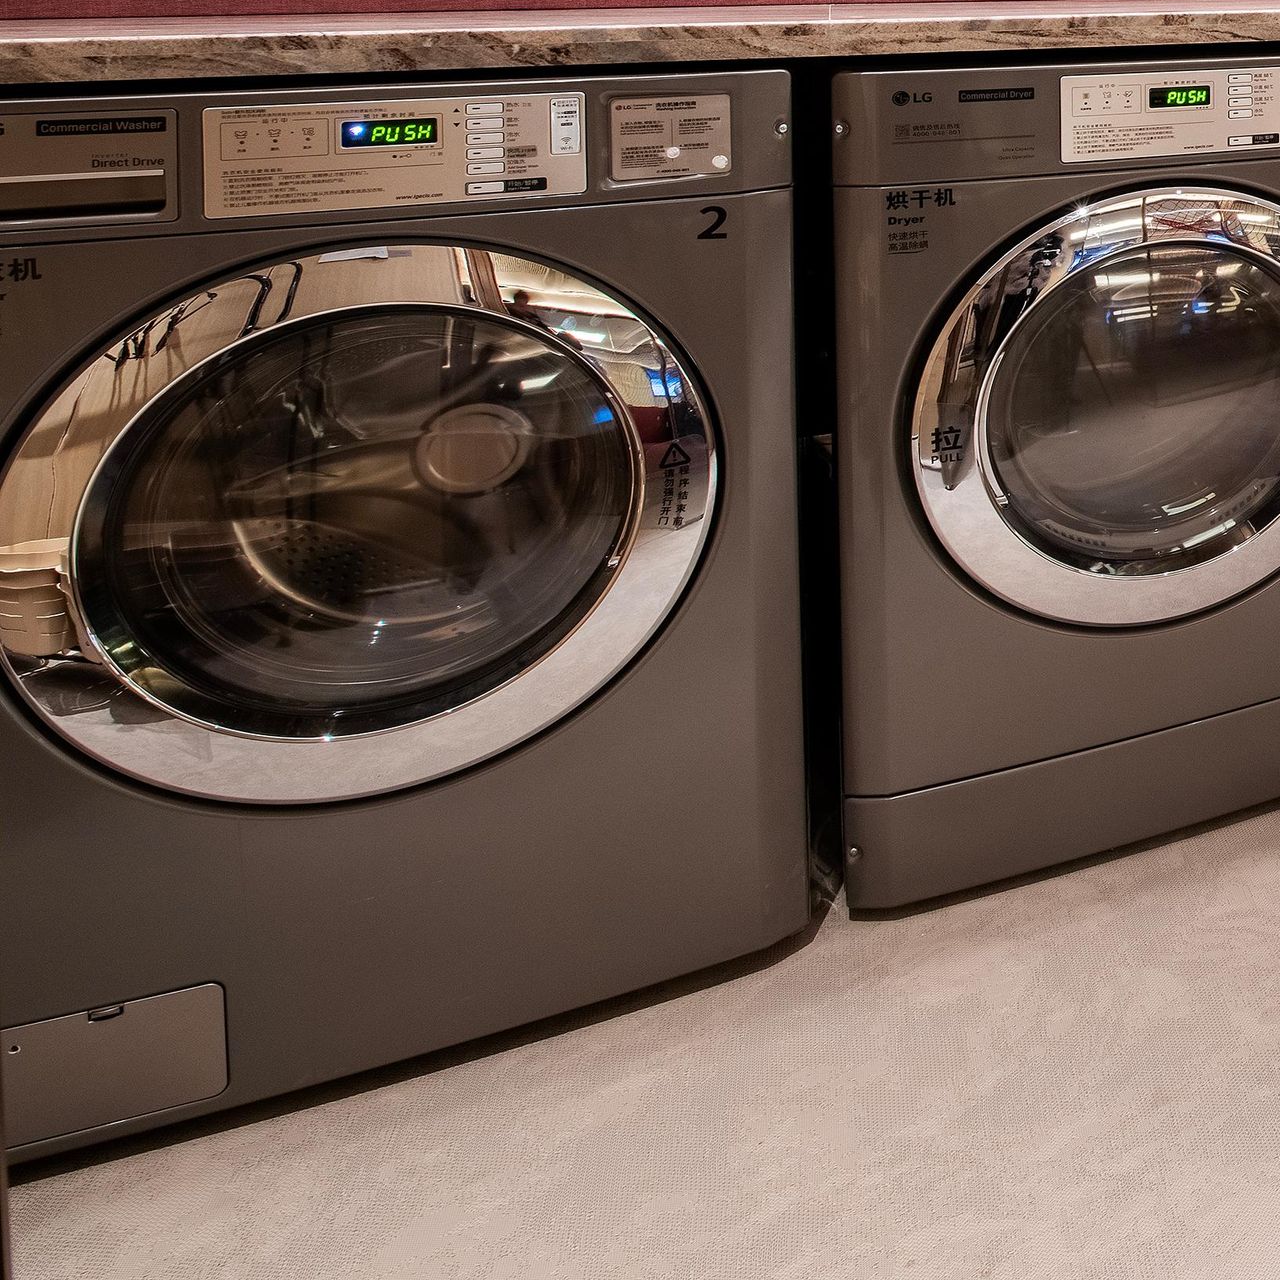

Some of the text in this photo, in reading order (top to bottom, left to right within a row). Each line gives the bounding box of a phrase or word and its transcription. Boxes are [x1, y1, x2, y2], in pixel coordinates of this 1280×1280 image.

[913, 93, 932, 103] LG
[961, 91, 1032, 101] Commercial Dryer
[1167, 90, 1206, 104] PUSH
[41, 121, 162, 133] Commercial Washer
[371, 125, 431, 142] PUSH
[92, 157, 164, 168] Direct Drive
[886, 189, 956, 210] 烘干机
[698, 206, 727, 239] 2
[888, 216, 925, 226] Dryer
[888, 231, 928, 241] 快速烘干
[0, 258, 42, 282] 机
[931, 426, 962, 453] 拉
[931, 453, 962, 464] PULL
[658, 469, 675, 526] 请勿强行开门
[673, 466, 690, 526] 程序结束前
